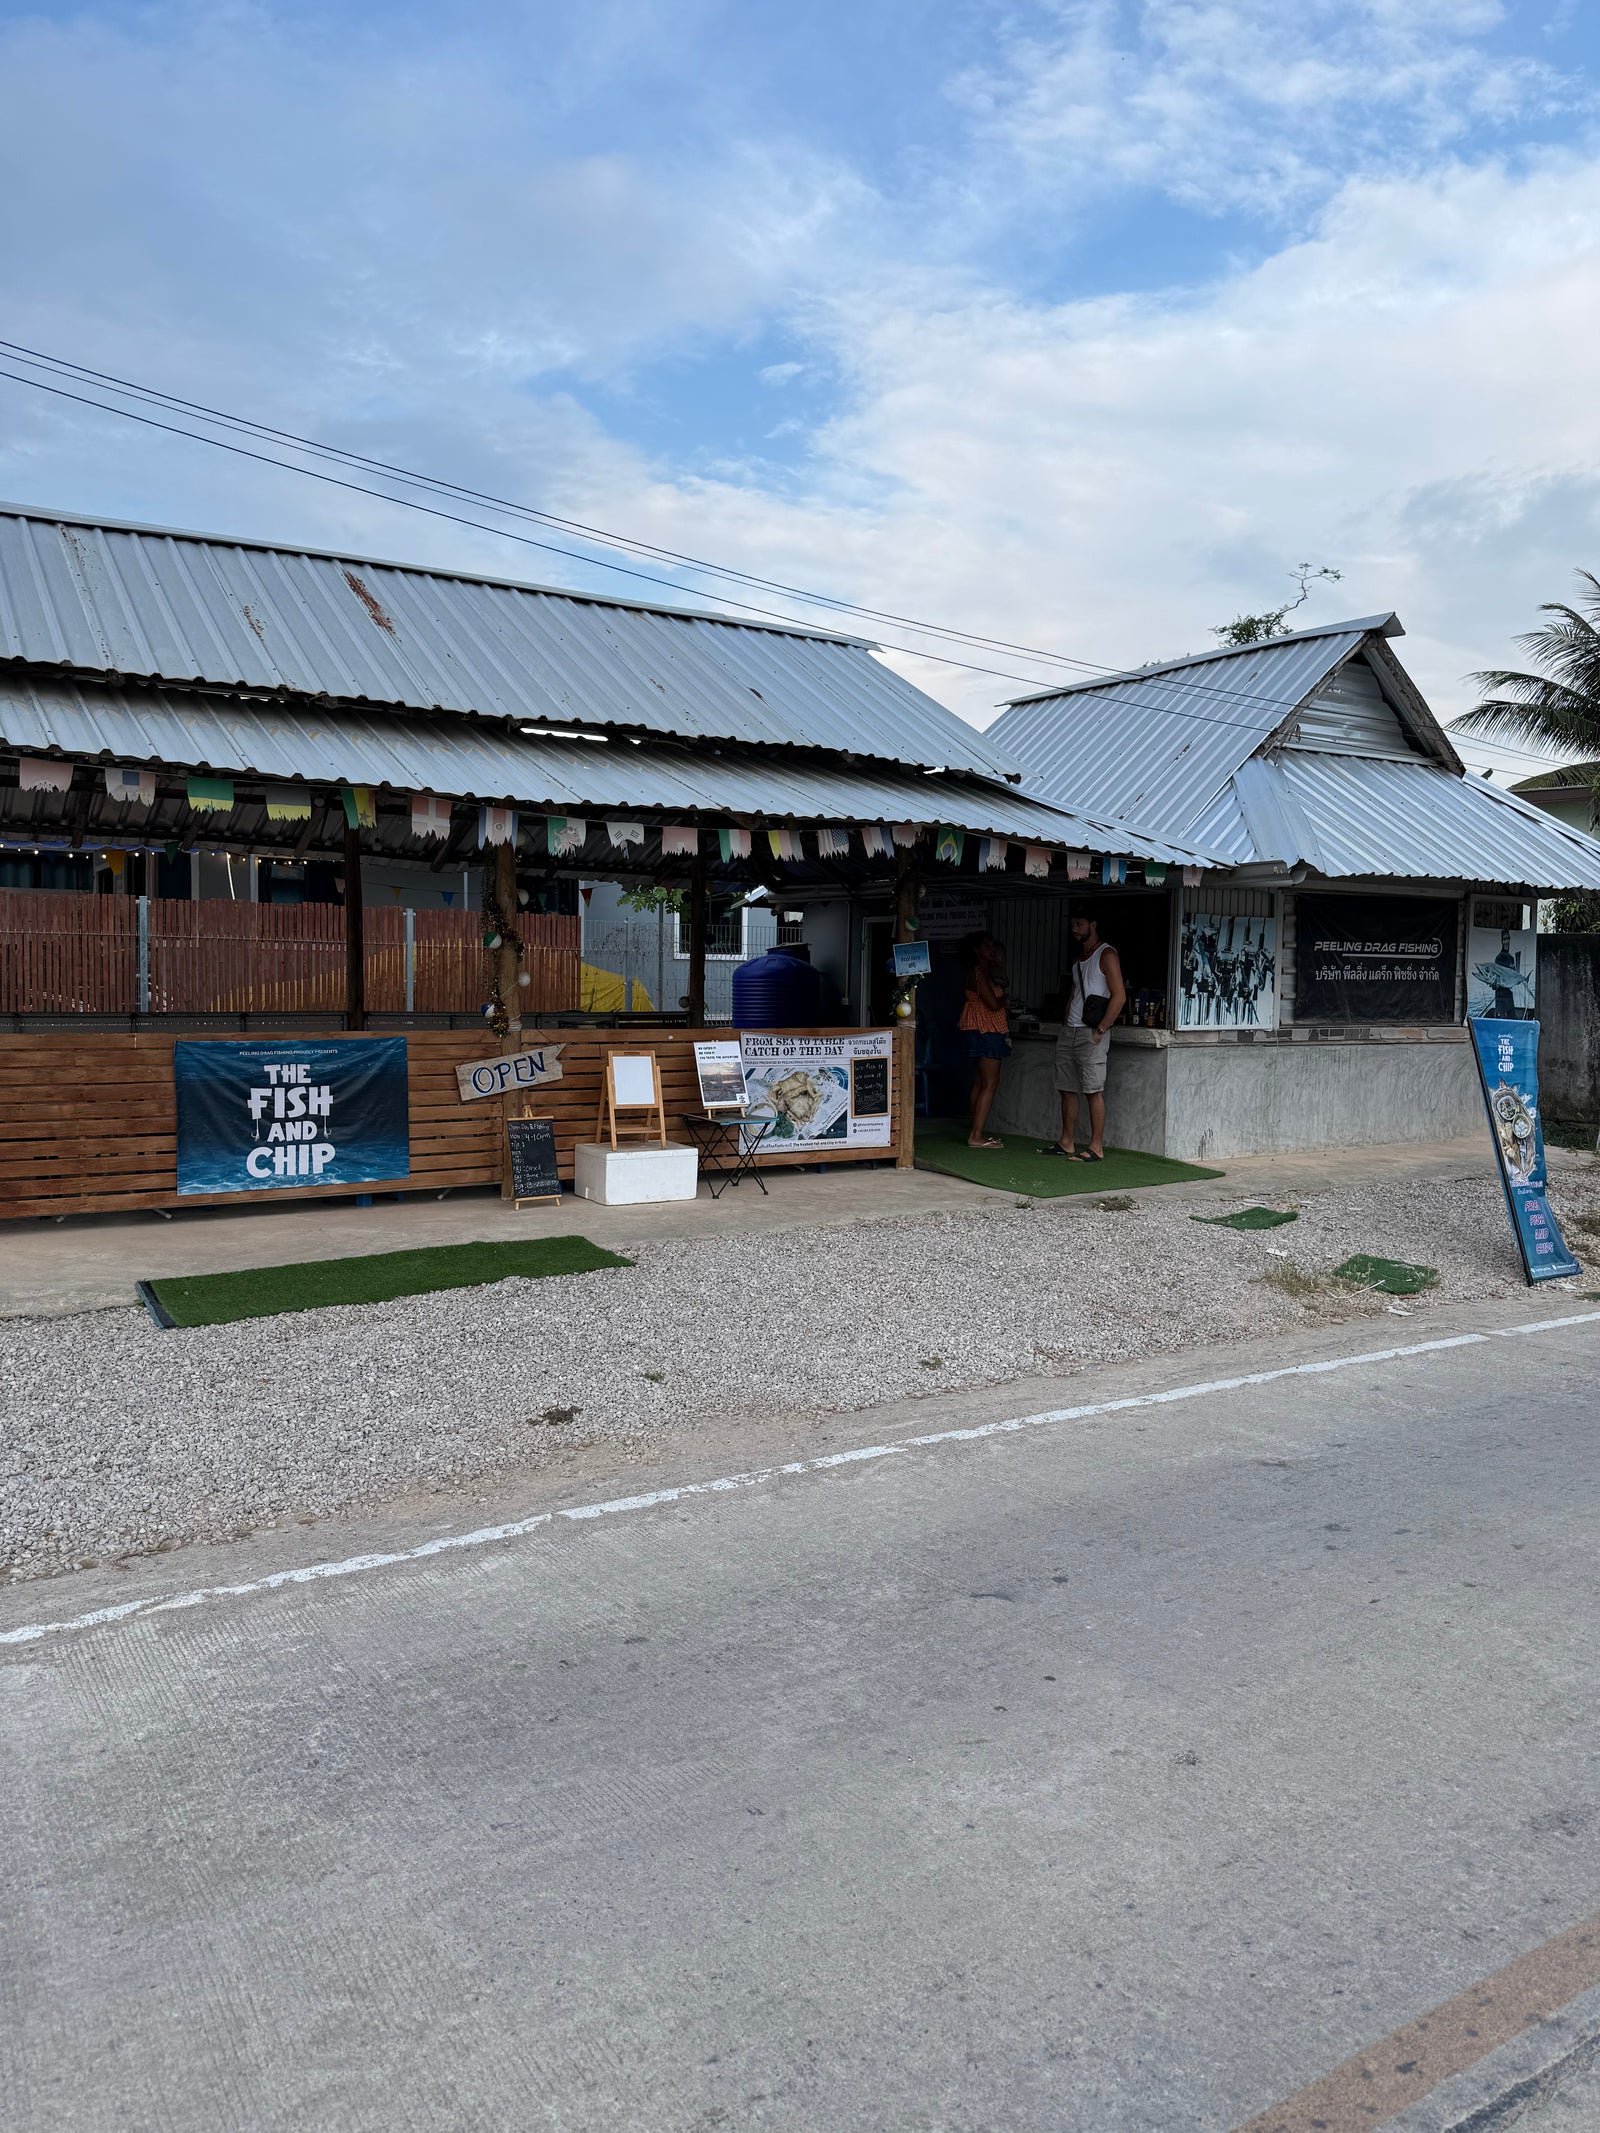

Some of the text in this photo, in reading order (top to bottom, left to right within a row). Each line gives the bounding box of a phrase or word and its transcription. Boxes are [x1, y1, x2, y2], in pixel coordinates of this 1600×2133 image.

[1314, 942, 1439, 953] PEELING DRAG FISHING
[1316, 964, 1341, 980] บริษัท
[1369, 964, 1392, 980] แดร็ก
[1418, 965, 1440, 981] จำกัด
[745, 1038, 773, 1046] FROM
[1498, 1045, 1513, 1055] FISH
[745, 1046, 844, 1056] CATCH OF THE DAY
[264, 1064, 312, 1084] THE
[472, 1052, 547, 1094] OPEN
[1498, 1062, 1514, 1072] CHIP
[247, 1086, 334, 1120] FISH
[267, 1121, 317, 1142] AND
[246, 1143, 336, 1178] CHIP
